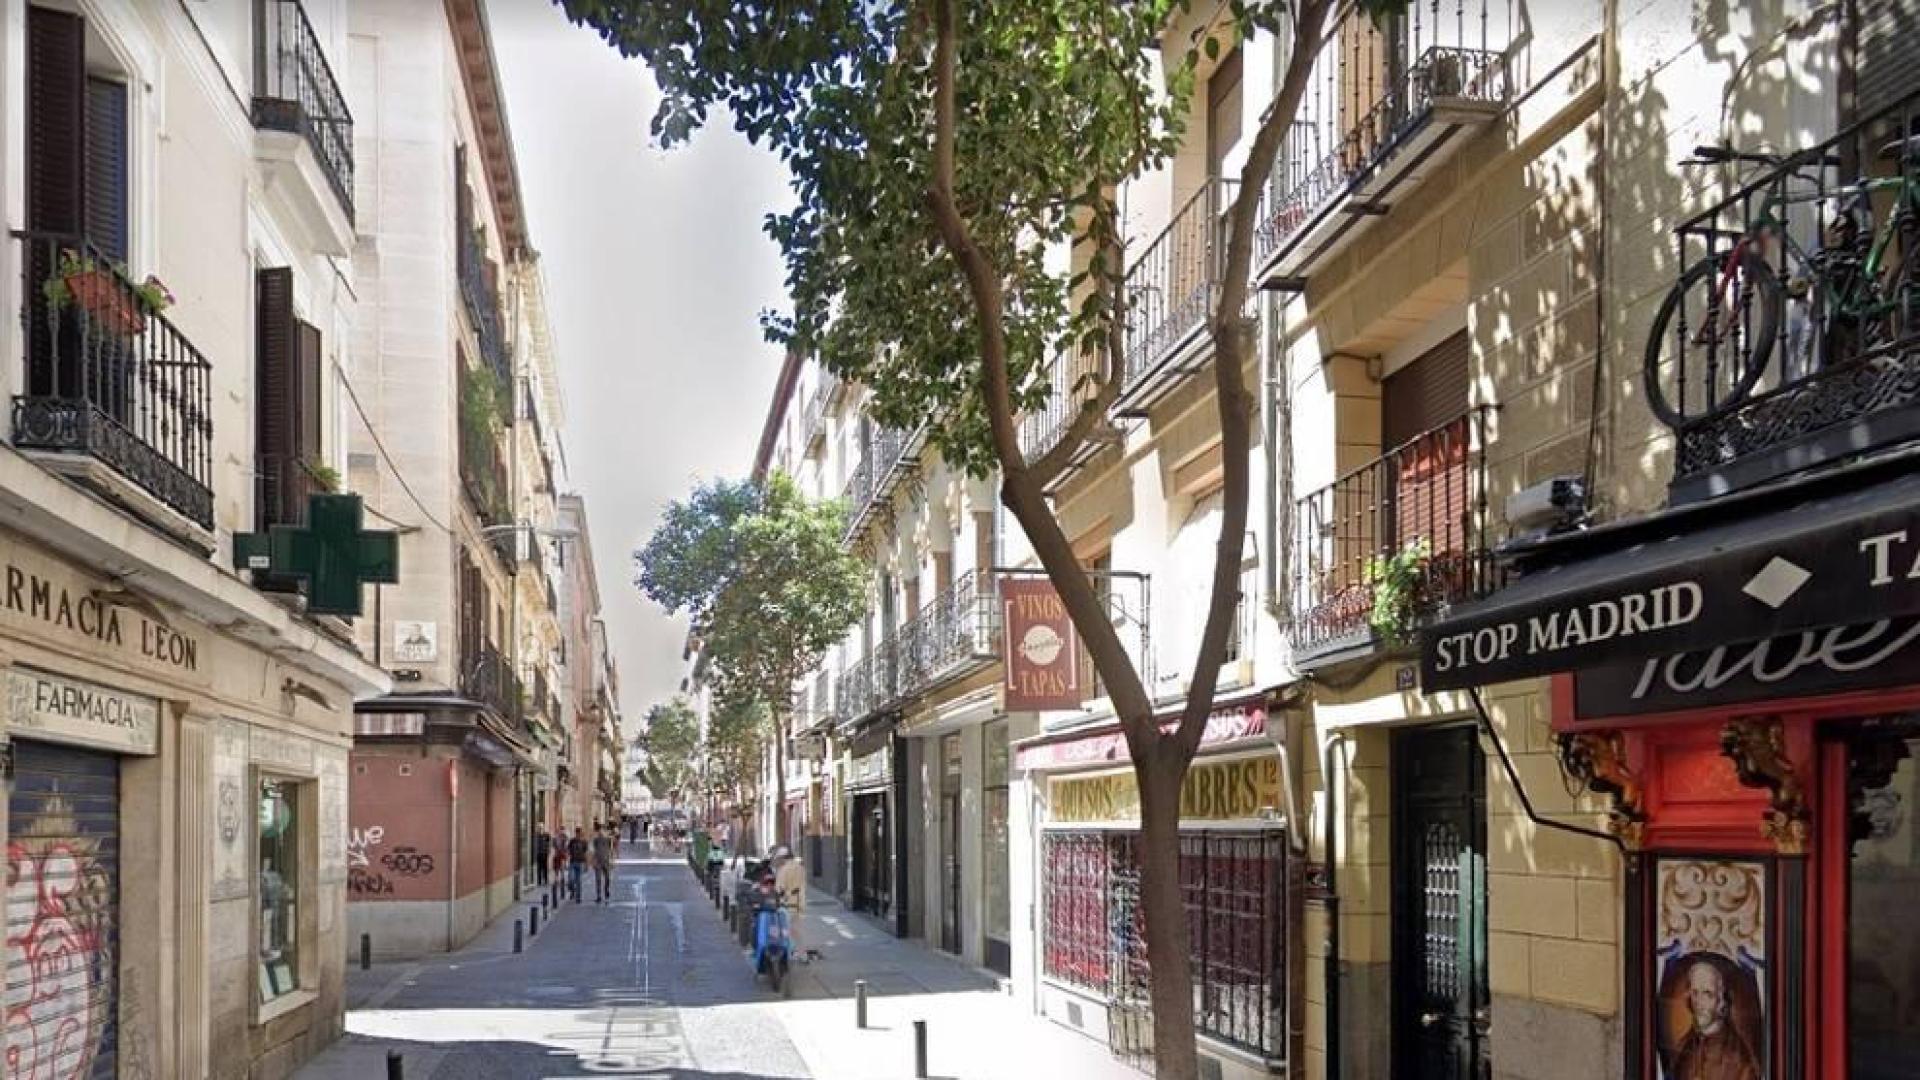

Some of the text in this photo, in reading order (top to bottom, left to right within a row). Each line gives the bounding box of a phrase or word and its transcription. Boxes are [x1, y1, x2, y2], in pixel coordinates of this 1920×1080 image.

[0, 565, 122, 646] RMACIA
[1016, 593, 1063, 620] VINOS
[1435, 530, 1920, 672] STOP MADRID T
[35, 680, 135, 728] FARMACIA
[1020, 670, 1066, 696] TAPAS
